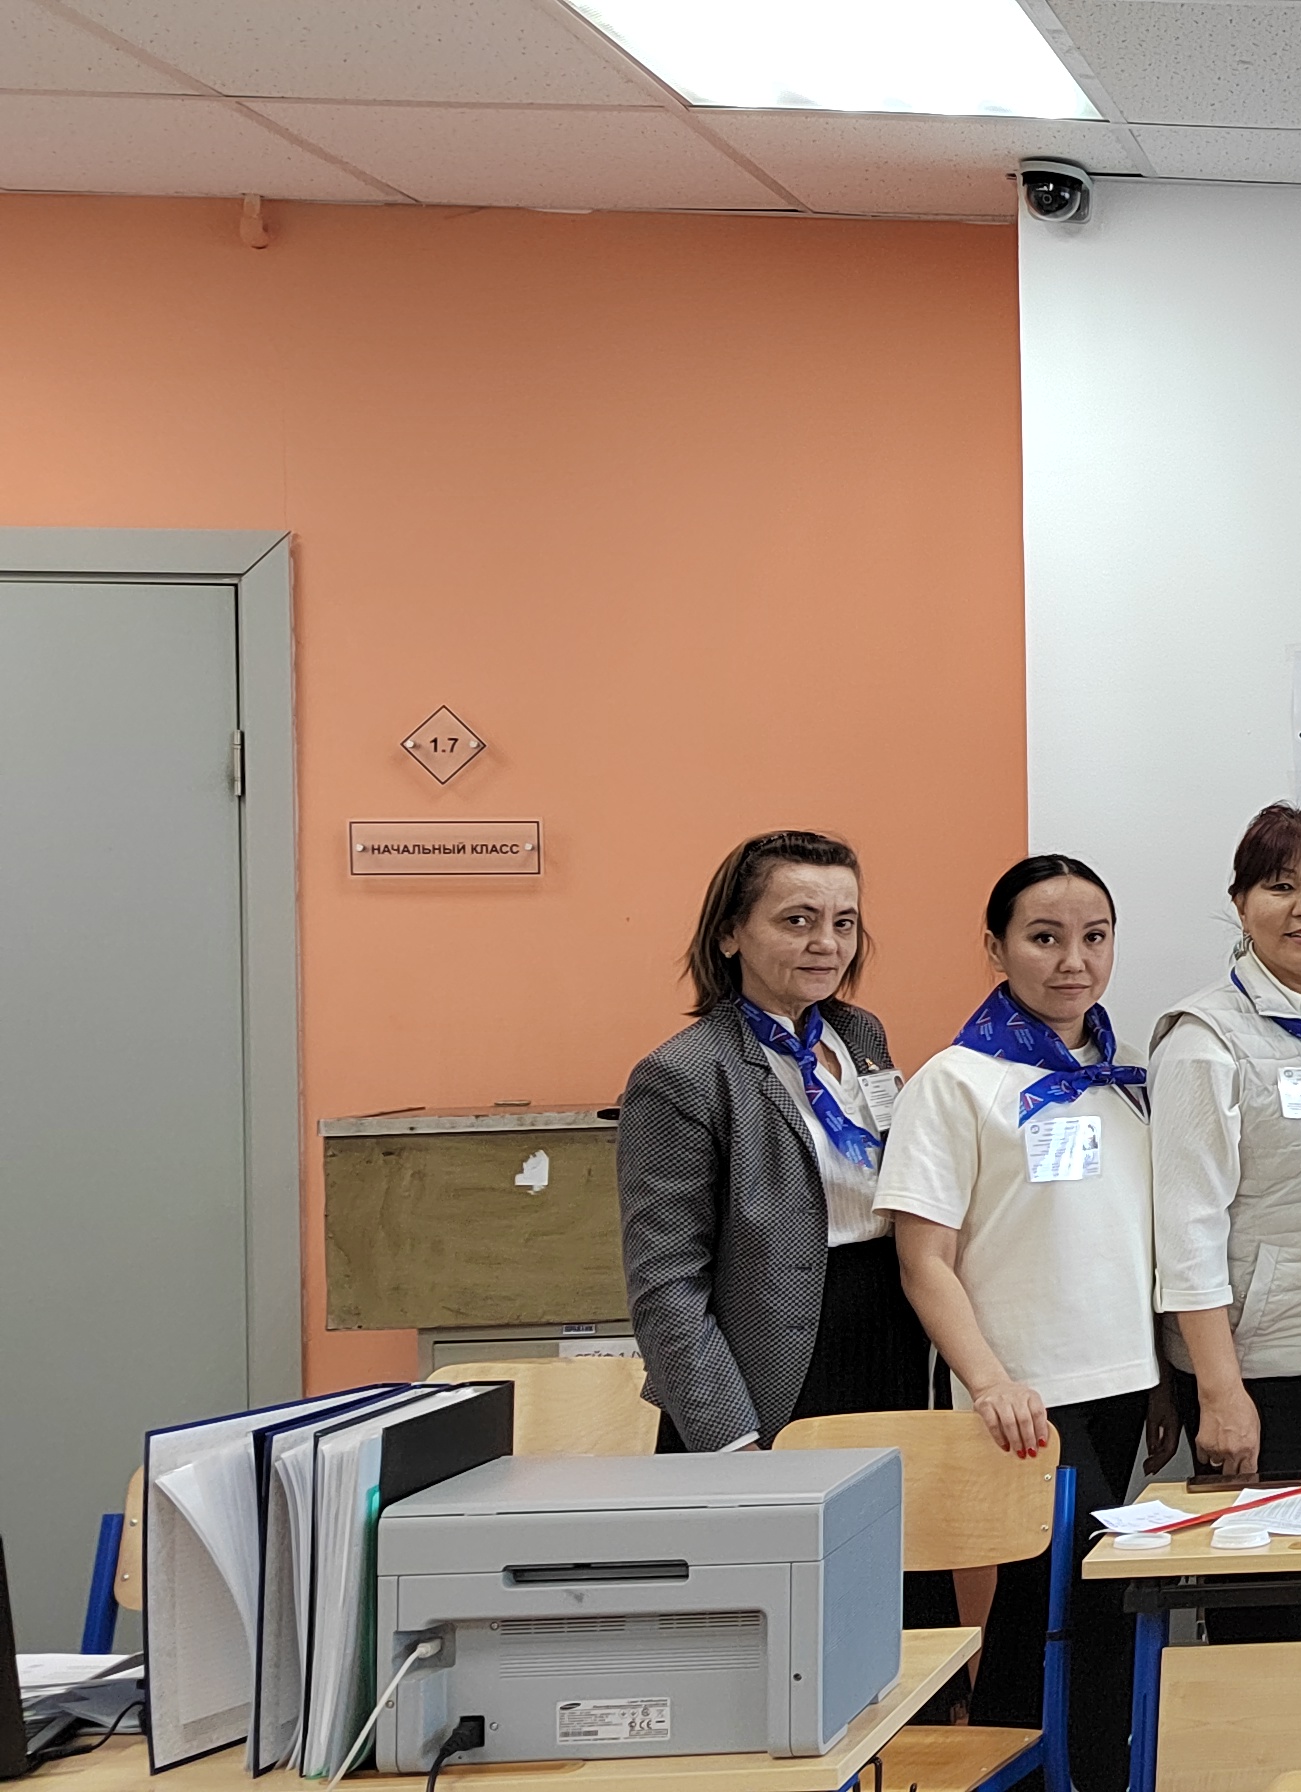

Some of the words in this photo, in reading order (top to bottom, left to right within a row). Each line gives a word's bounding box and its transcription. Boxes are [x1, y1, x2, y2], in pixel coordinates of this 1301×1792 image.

[430, 736, 460, 753] 1.7
[371, 842, 466, 855] НАЧАЛЬНЫЙ
[470, 843, 520, 855] КЛАСС
